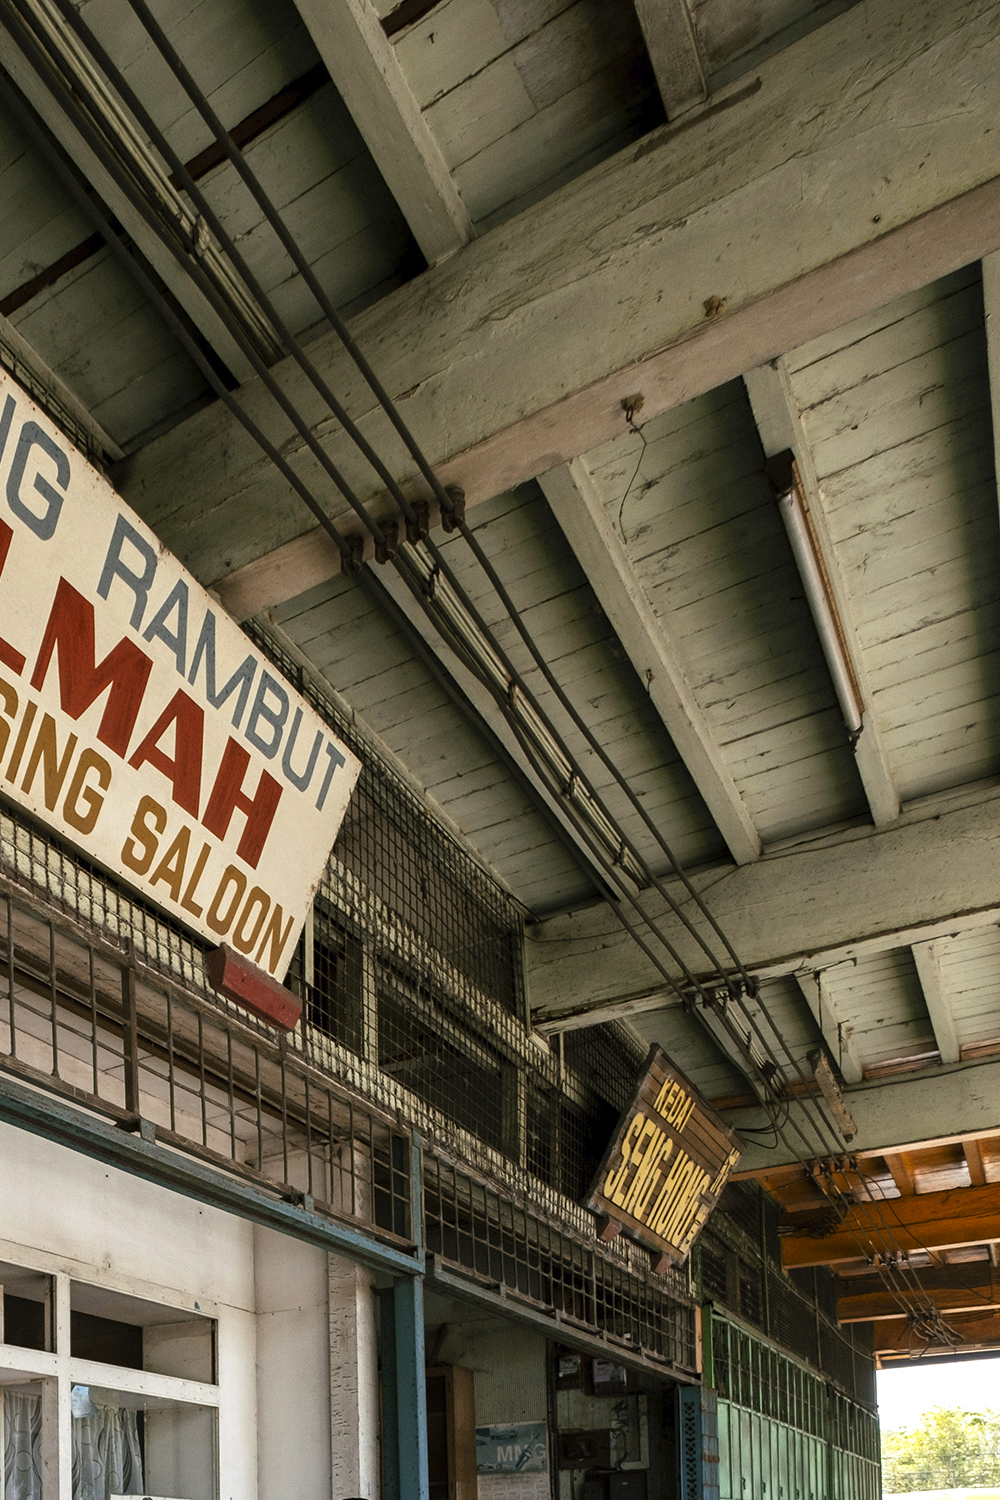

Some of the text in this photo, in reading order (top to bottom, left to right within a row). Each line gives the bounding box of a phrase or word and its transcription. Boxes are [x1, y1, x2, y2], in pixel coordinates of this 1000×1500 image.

[97, 514, 345, 811] RAMBUT
[121, 795, 295, 975] SALOON
[604, 1112, 673, 1220] SENG
[645, 1149, 711, 1246] HONG
[653, 1078, 696, 1133] KEDAI
